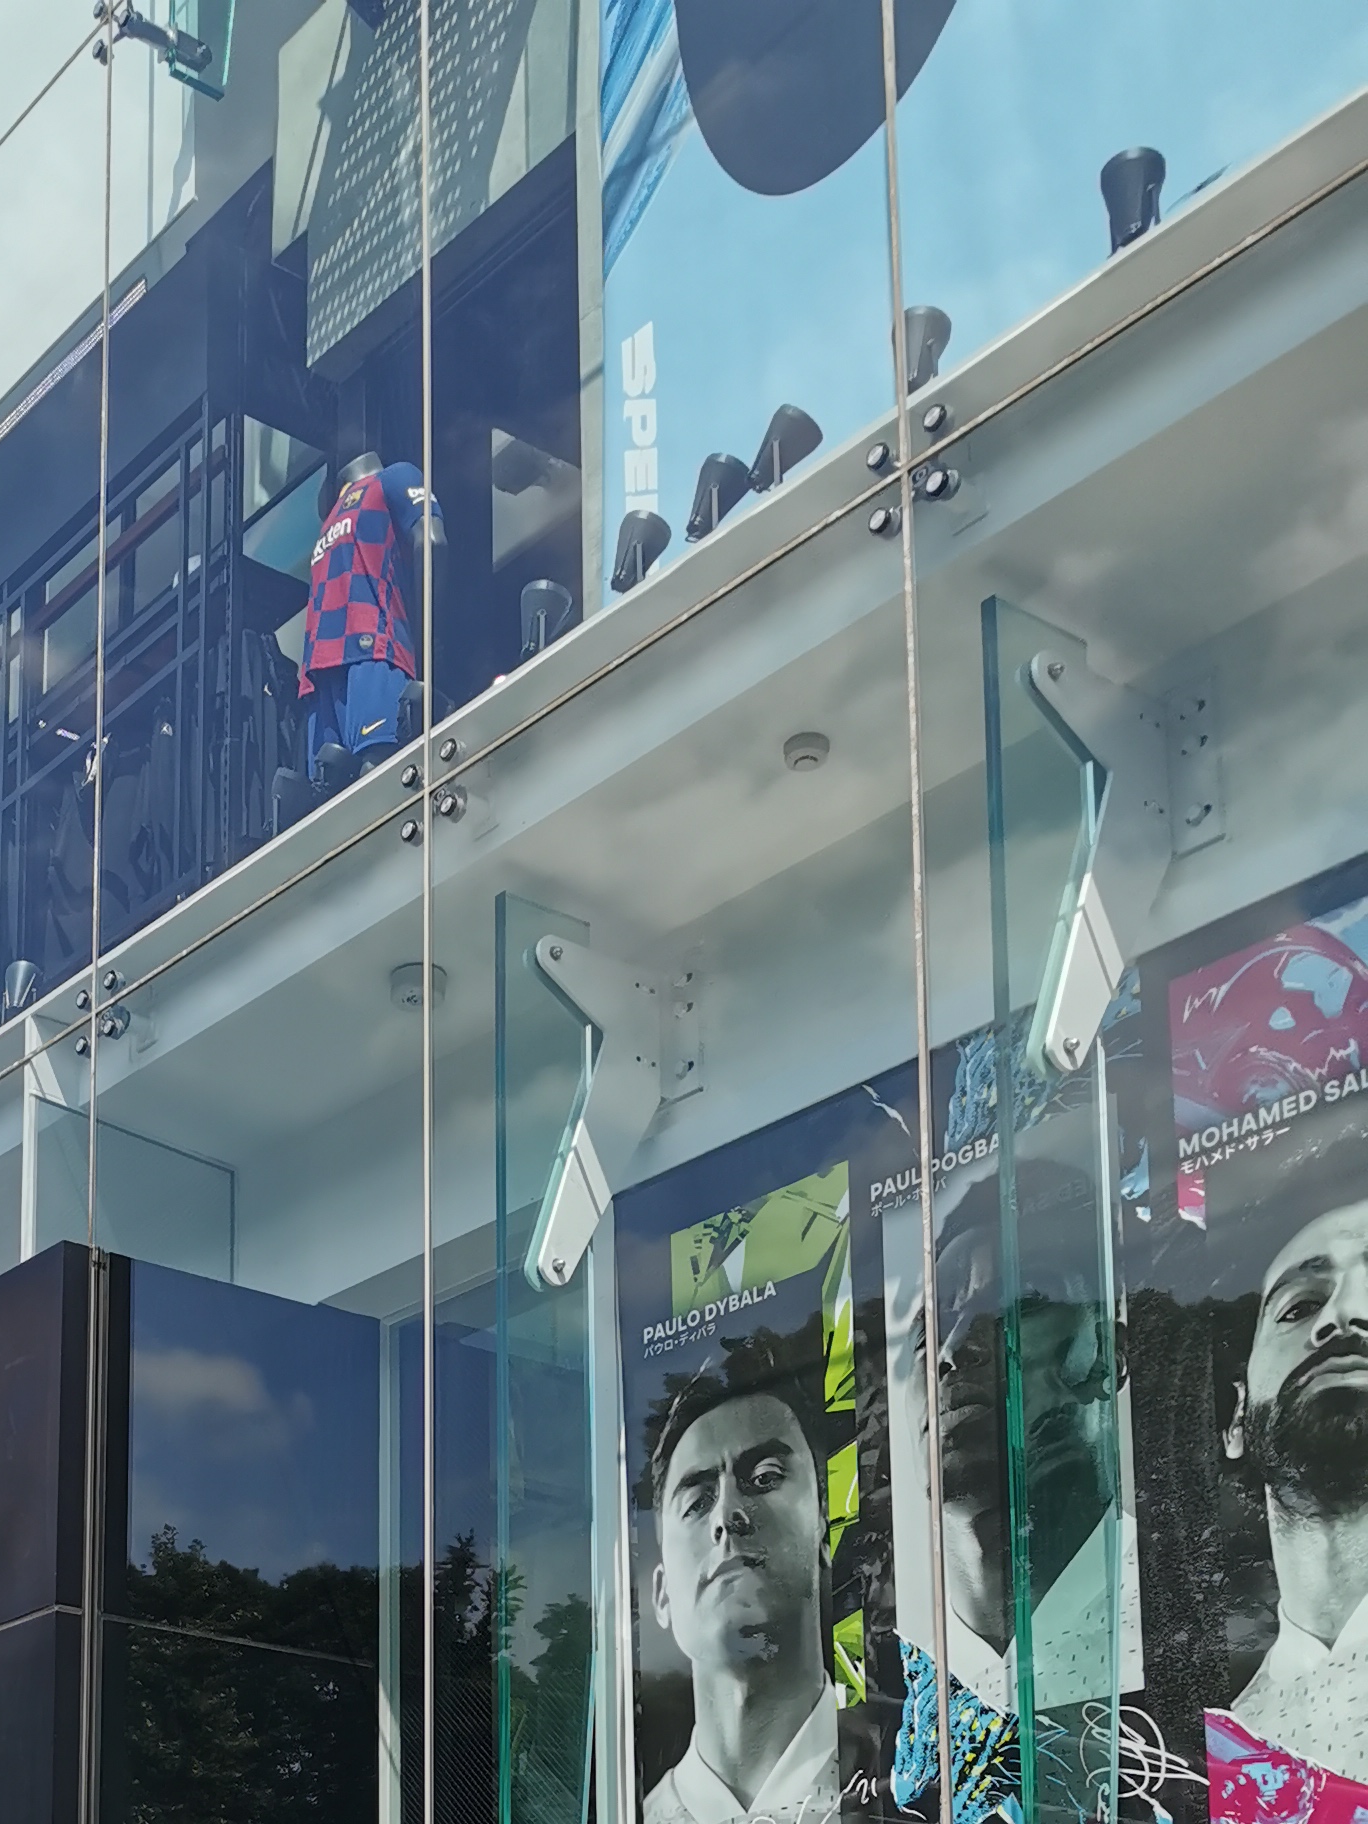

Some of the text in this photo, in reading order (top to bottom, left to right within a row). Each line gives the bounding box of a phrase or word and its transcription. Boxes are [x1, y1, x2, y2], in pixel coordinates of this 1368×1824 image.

[1178, 1089, 1318, 1159] MOHAMED
[1180, 1126, 1291, 1174] モハメド・サラー
[870, 1133, 1000, 1203] PAUL POGBA
[643, 1280, 777, 1344] PAULO DYBALA
